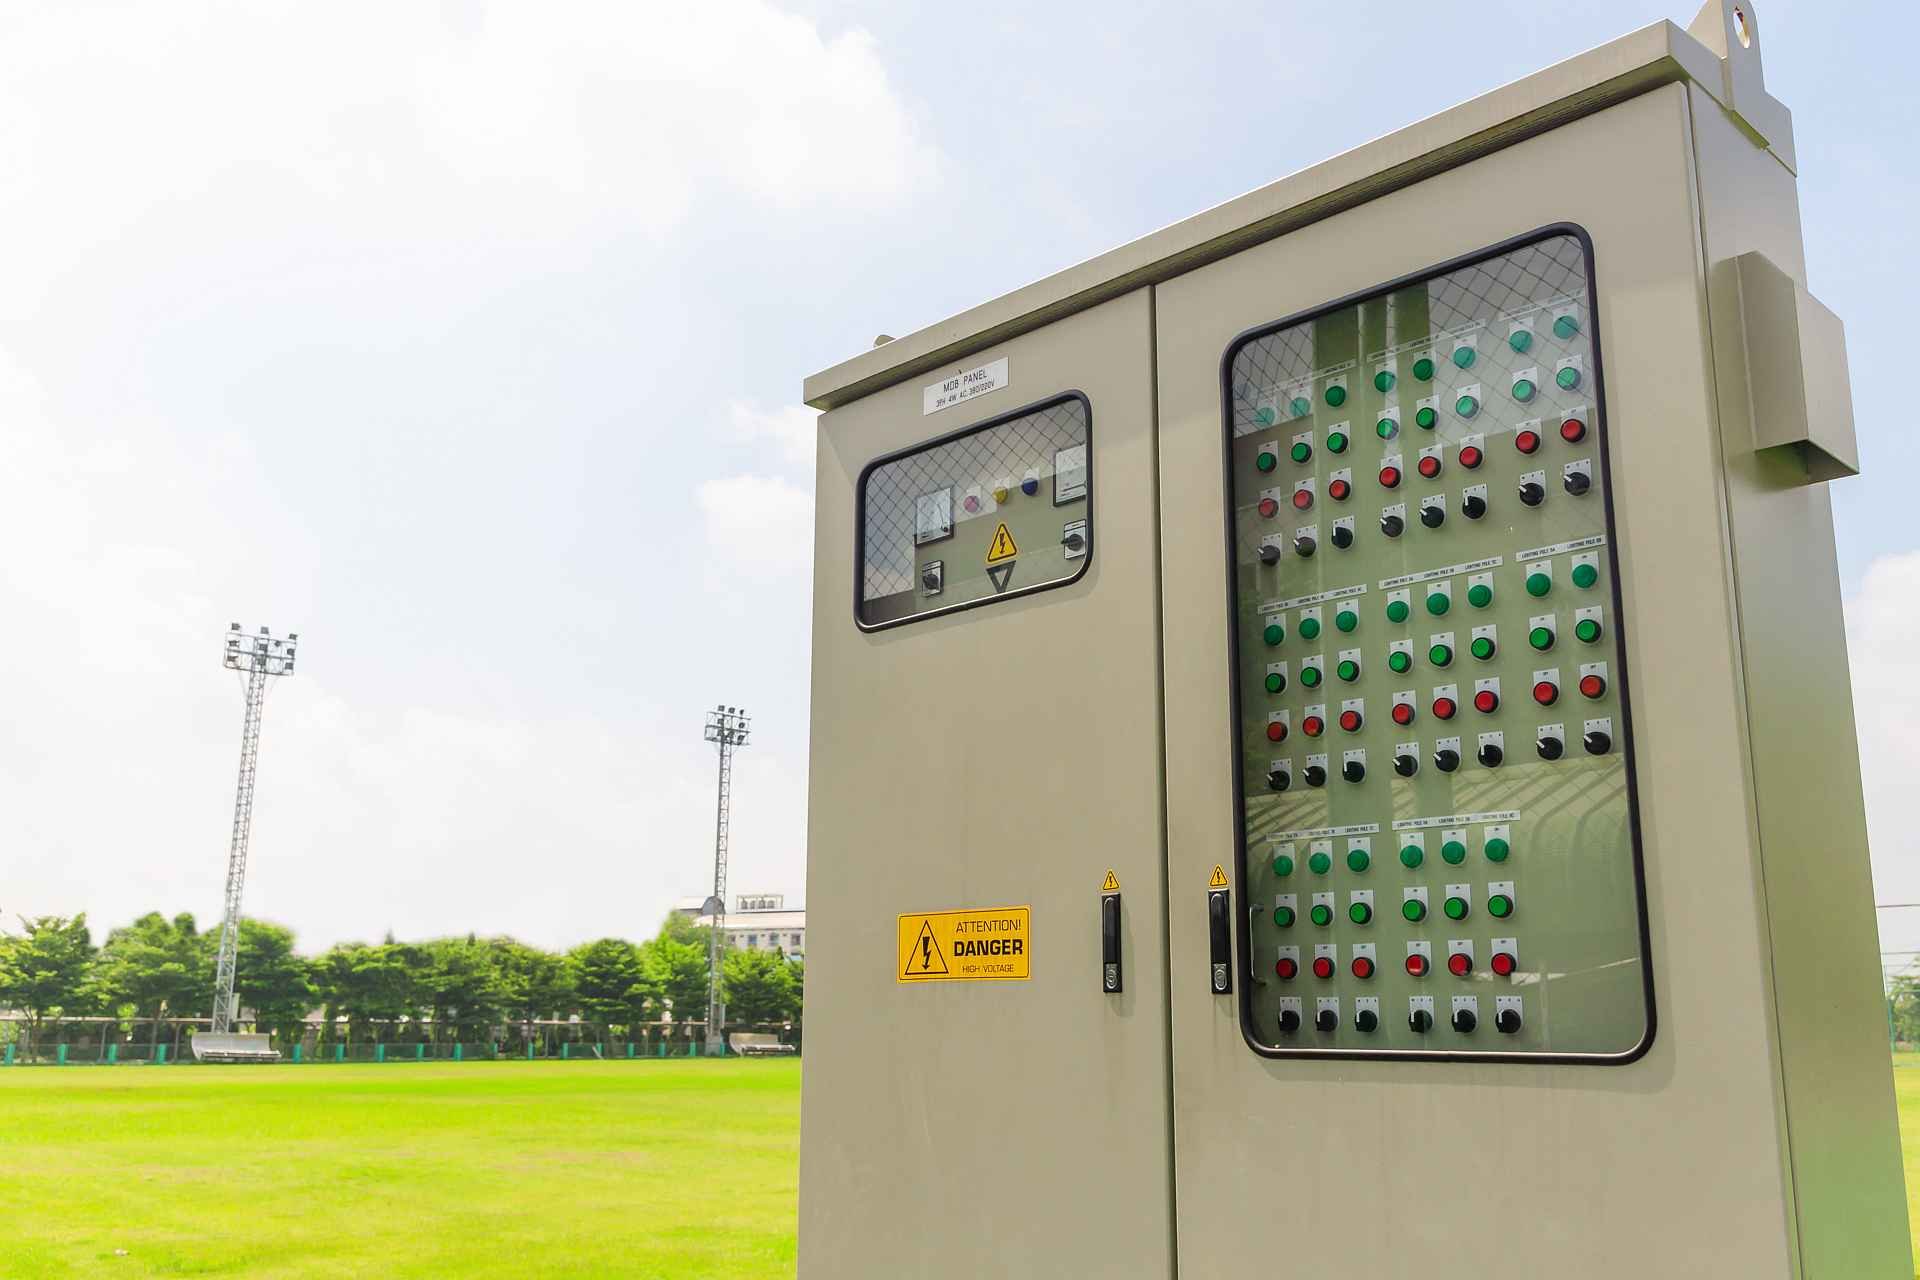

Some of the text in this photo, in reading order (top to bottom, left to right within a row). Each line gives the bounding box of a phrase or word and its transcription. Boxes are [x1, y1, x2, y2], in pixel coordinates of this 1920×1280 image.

[943, 369, 987, 393] MDB PANEL
[956, 919, 1021, 933] ATTENTION!
[954, 939, 1023, 956] DANGER
[962, 964, 1014, 973] HIGH VOLTAGE
